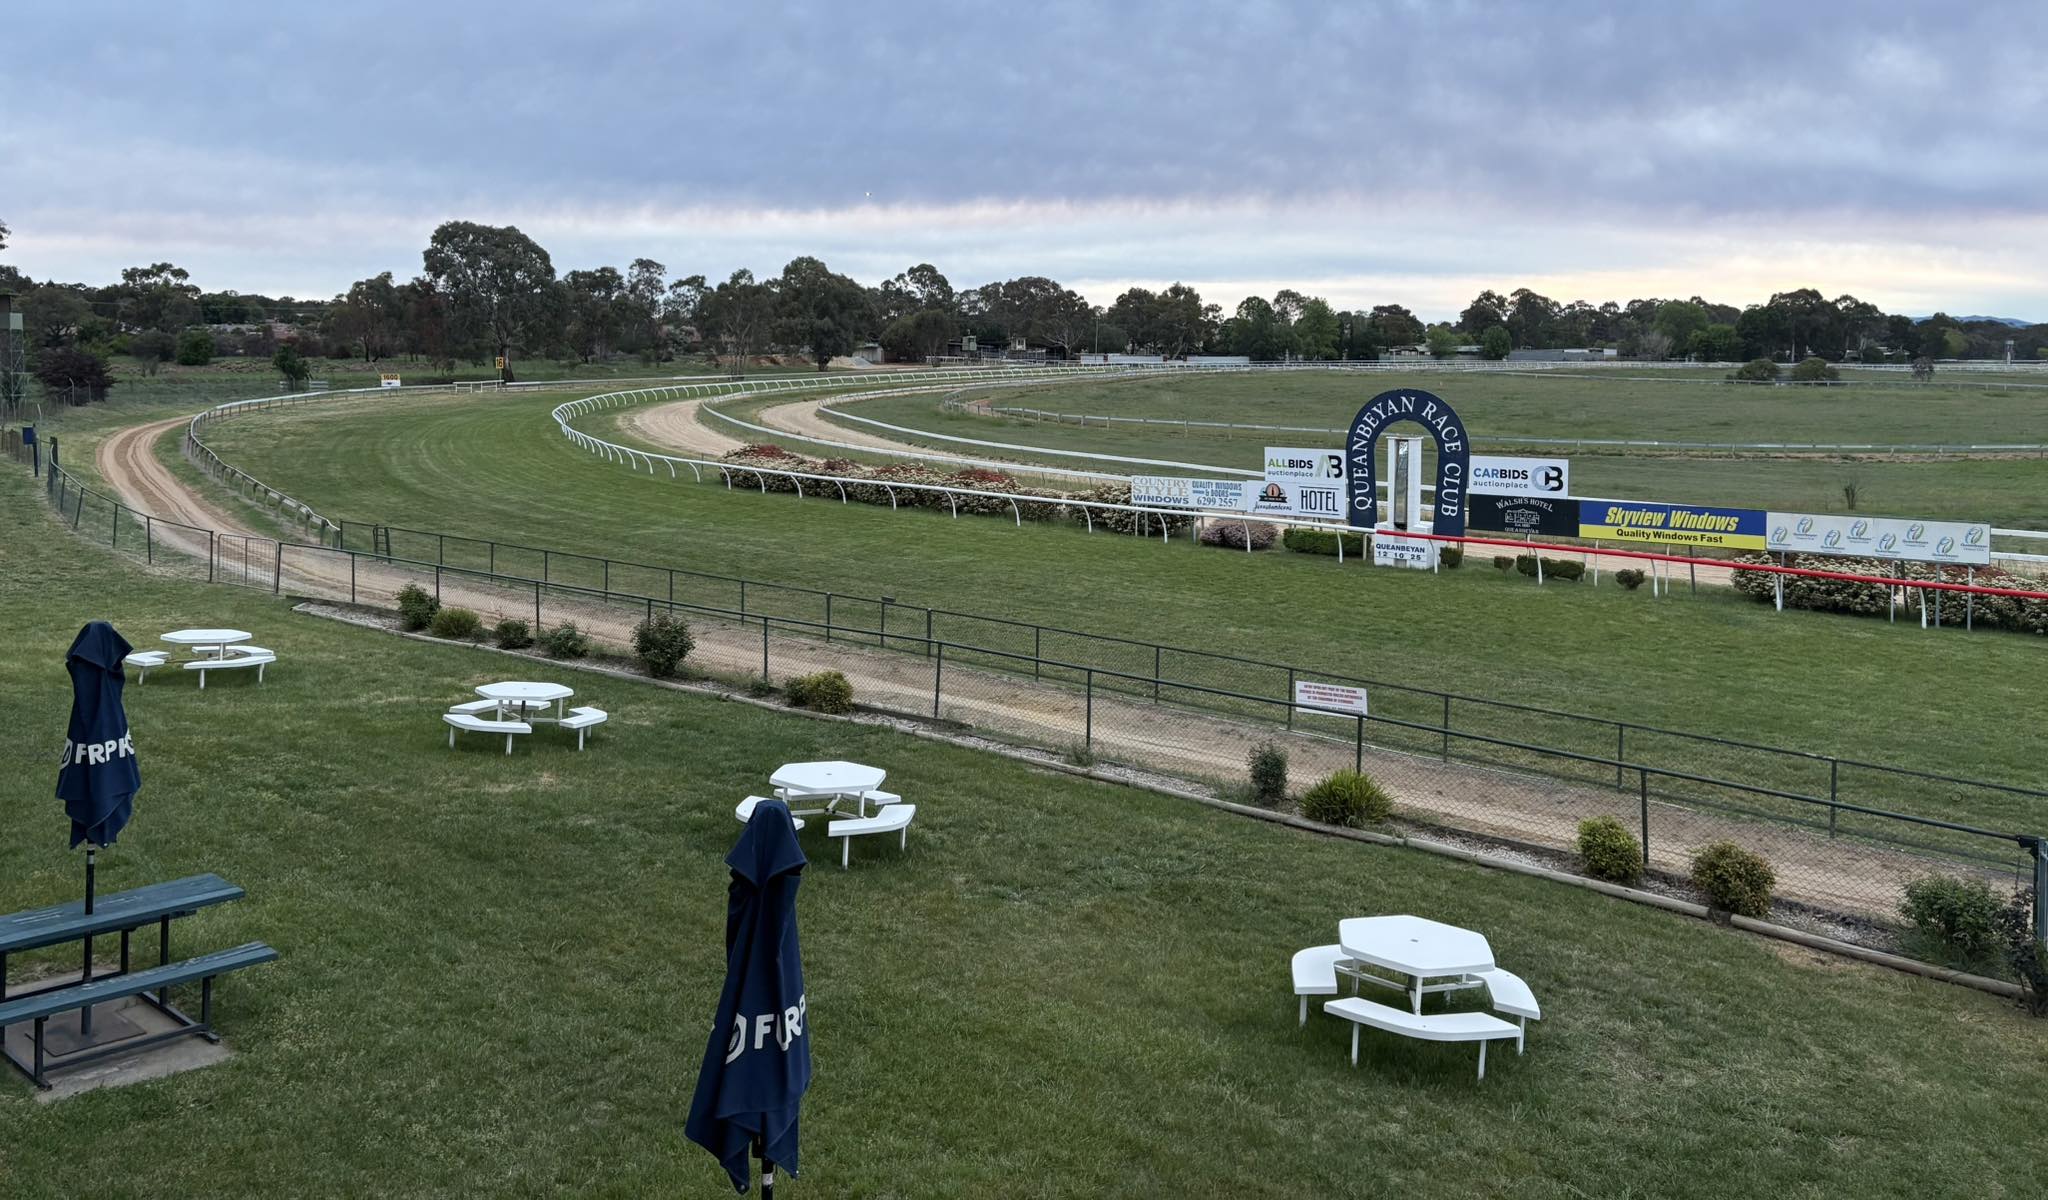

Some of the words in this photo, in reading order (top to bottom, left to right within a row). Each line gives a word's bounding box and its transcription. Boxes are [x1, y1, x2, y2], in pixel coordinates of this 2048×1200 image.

[1421, 401, 1462, 453] RACE
[1352, 396, 1416, 510] QUEANBEYAN
[1268, 458, 1313, 469] ALLBIDS
[1267, 469, 1314, 478] auctionplace
[1473, 467, 1529, 480] CARBIDS
[1132, 476, 1188, 488] COUNTRY
[1192, 480, 1213, 489] QUALITY
[1215, 482, 1242, 491] WINDOWS
[1473, 480, 1528, 489] auctionplace
[1132, 485, 1189, 497] STYLE
[1205, 489, 1210, 497] &
[1211, 489, 1229, 498] DOORS
[1441, 462, 1462, 517] CLUB
[1133, 494, 1189, 505] WINDOWS
[1197, 497, 1216, 506] 6299
[1218, 498, 1238, 508] 2557
[1300, 489, 1339, 512] HOTEL
[1529, 498, 1553, 513] HOTEL
[1605, 506, 1666, 527] Skyview
[1669, 509, 1740, 532] Windows
[1616, 528, 1651, 540] Quality
[1653, 531, 1698, 542] Windows
[1700, 533, 1723, 543] Fast
[1376, 543, 1425, 553] QUEANBEYAN
